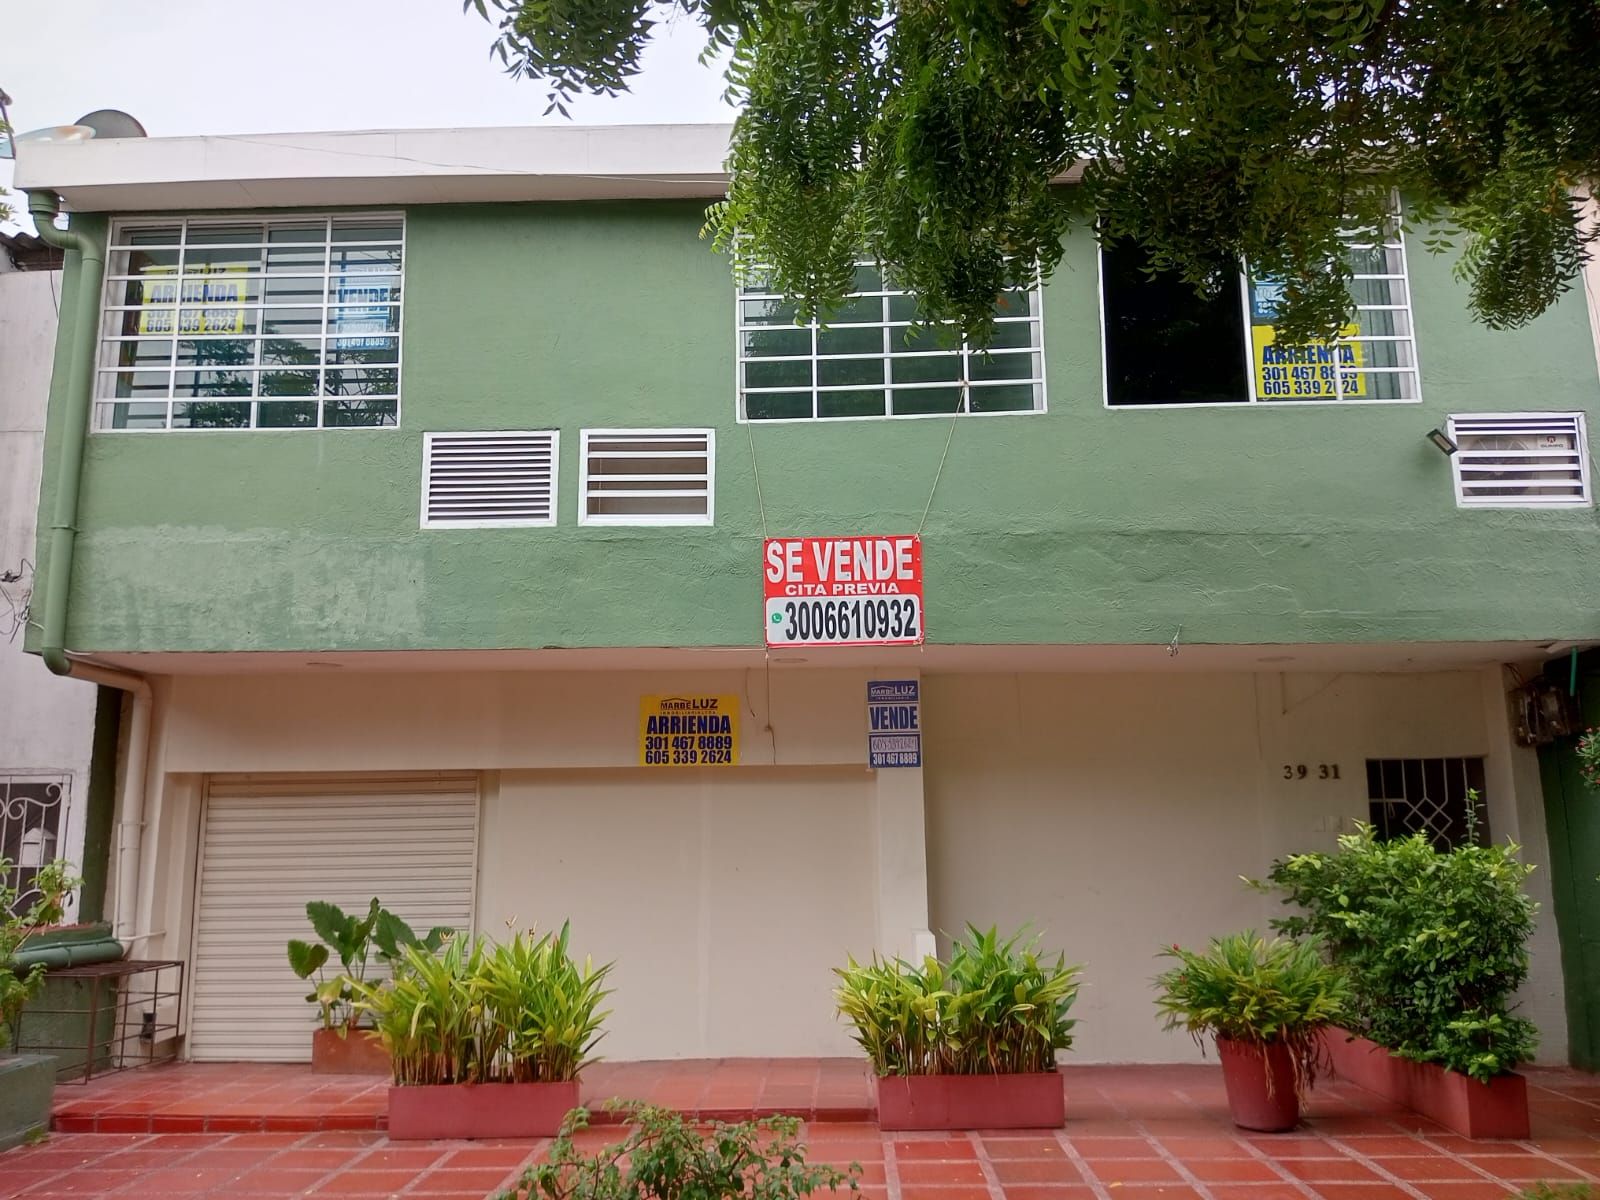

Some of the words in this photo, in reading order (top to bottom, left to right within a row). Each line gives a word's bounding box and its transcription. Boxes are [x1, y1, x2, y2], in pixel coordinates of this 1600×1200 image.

[146, 319, 171, 332] 605
[204, 318, 236, 332] 2624
[1263, 345, 1354, 364] ARRIENA
[1262, 366, 1288, 380] 301
[1291, 366, 1316, 380] 467
[1264, 380, 1290, 394] 605
[1294, 380, 1320, 394] 339
[1325, 380, 1358, 394] 224
[766, 541, 802, 584] SE
[812, 539, 914, 582] VENDE
[785, 584, 826, 596] CITA
[832, 582, 900, 595] PREVIA
[785, 599, 917, 640] 3006610932
[646, 716, 732, 734] ARRIENDA
[870, 706, 918, 730] VENDE
[646, 736, 669, 750] 301
[672, 736, 696, 750] 467
[698, 736, 732, 750] 8889
[646, 750, 670, 764] 605
[673, 750, 698, 764] 339
[701, 750, 732, 764] 2624
[1283, 764, 1308, 780] 39
[1319, 764, 1341, 780] 31
